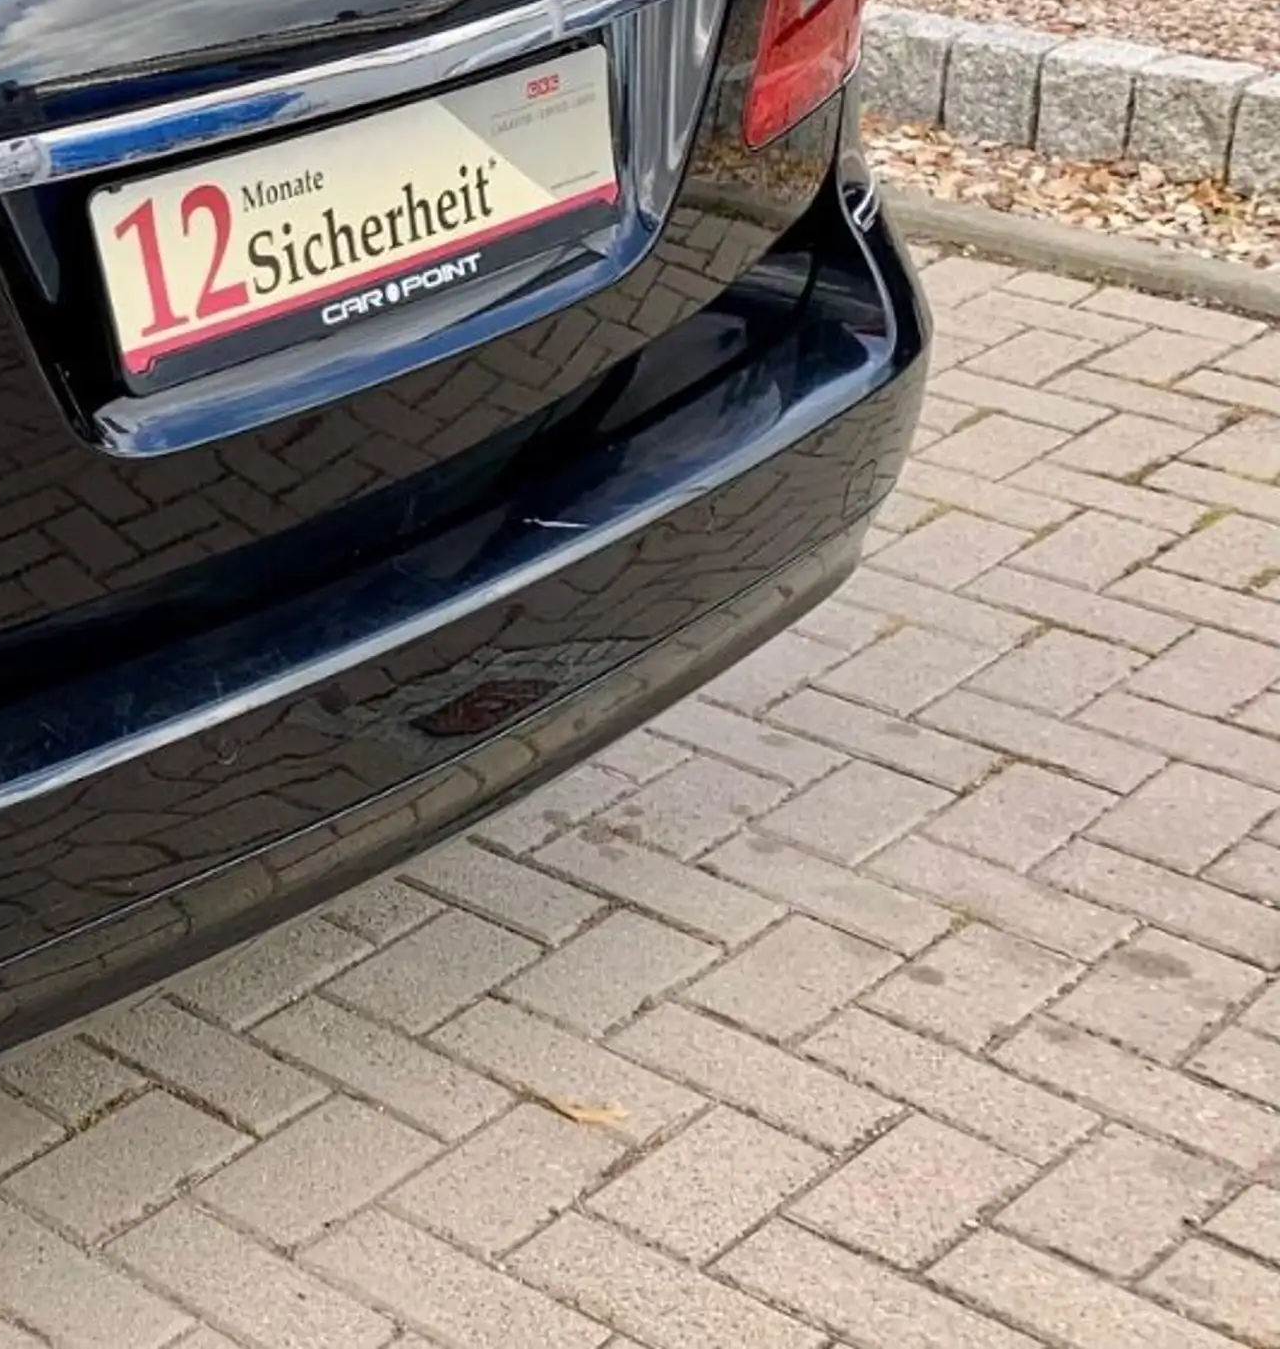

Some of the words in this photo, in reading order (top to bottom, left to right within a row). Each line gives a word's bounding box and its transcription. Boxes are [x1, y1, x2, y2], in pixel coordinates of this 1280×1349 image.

[114, 184, 249, 338] 12
[241, 168, 324, 213] Monate
[321, 288, 384, 325] CAR
[400, 252, 482, 298] POINT
